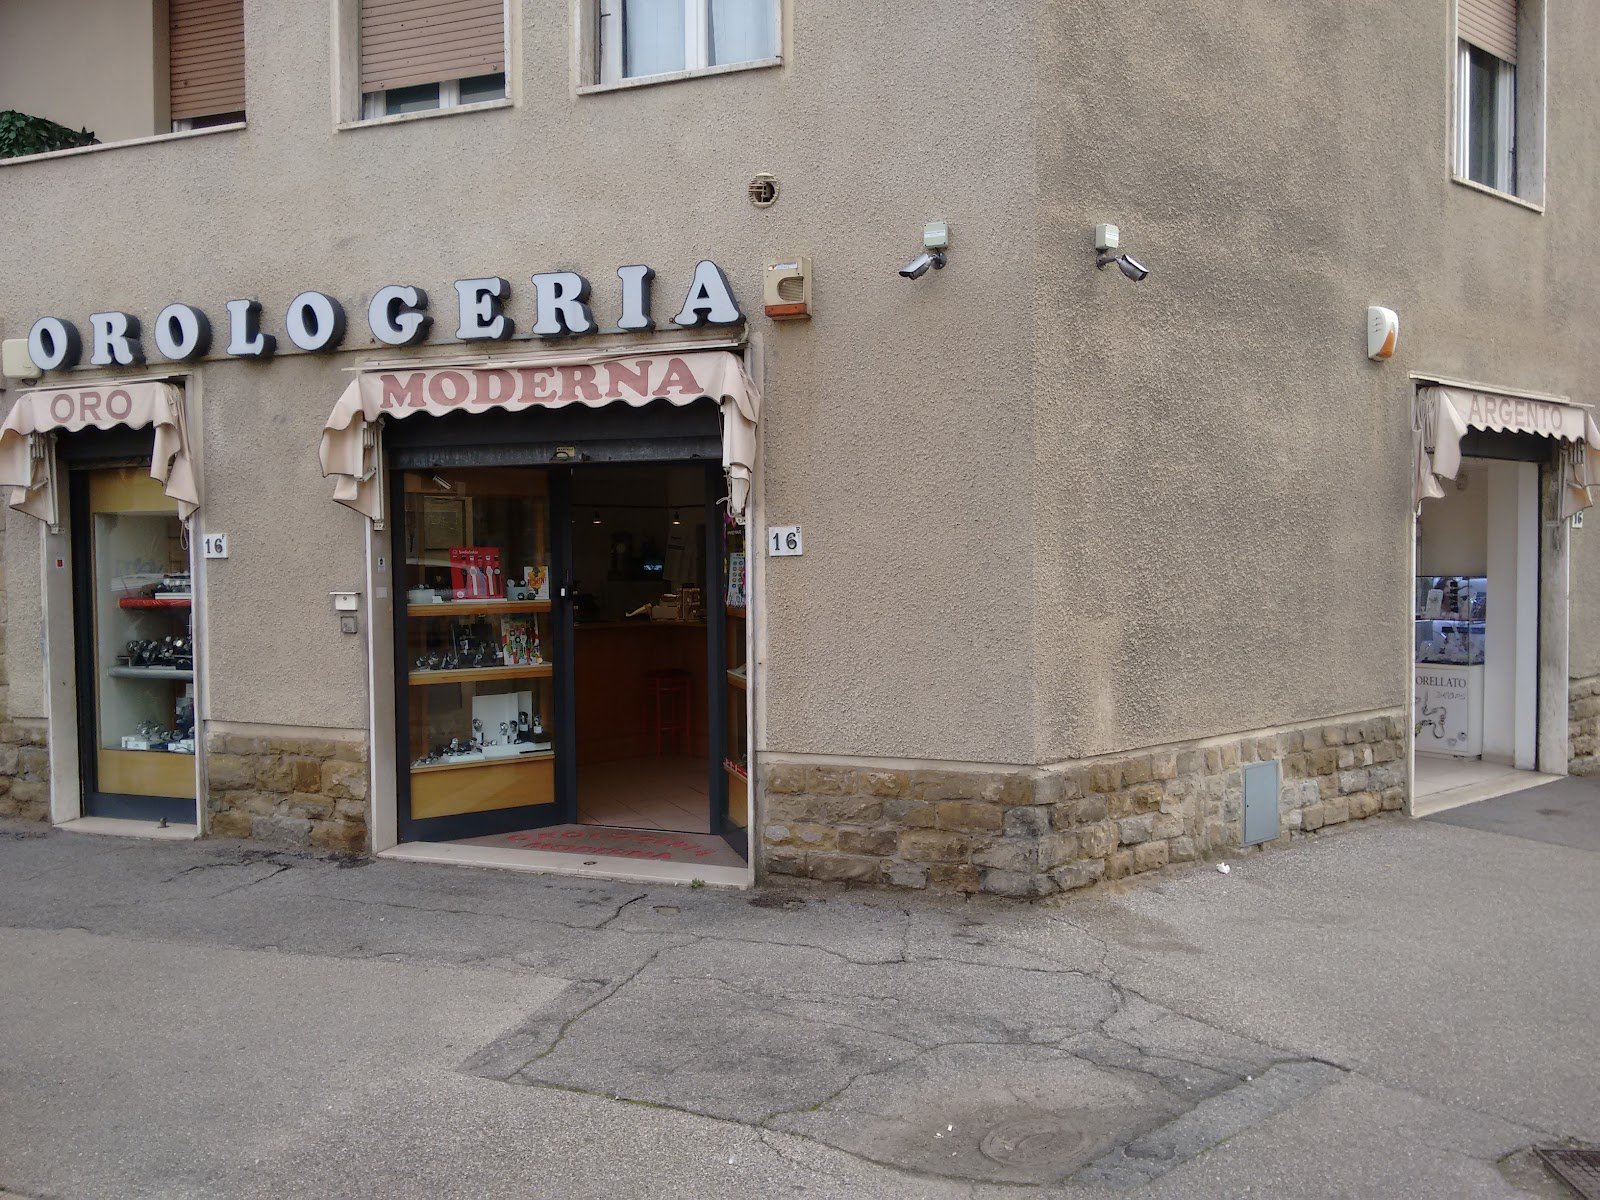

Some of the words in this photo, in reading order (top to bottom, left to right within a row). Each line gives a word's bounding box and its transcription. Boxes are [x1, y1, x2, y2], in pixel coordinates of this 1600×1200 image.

[28, 260, 743, 370] OROLOGERIA
[380, 357, 704, 409] MODERNA
[50, 389, 132, 423] ORO
[1468, 394, 1564, 431] ARGENTO
[1415, 676, 1467, 688] ORELLATO
